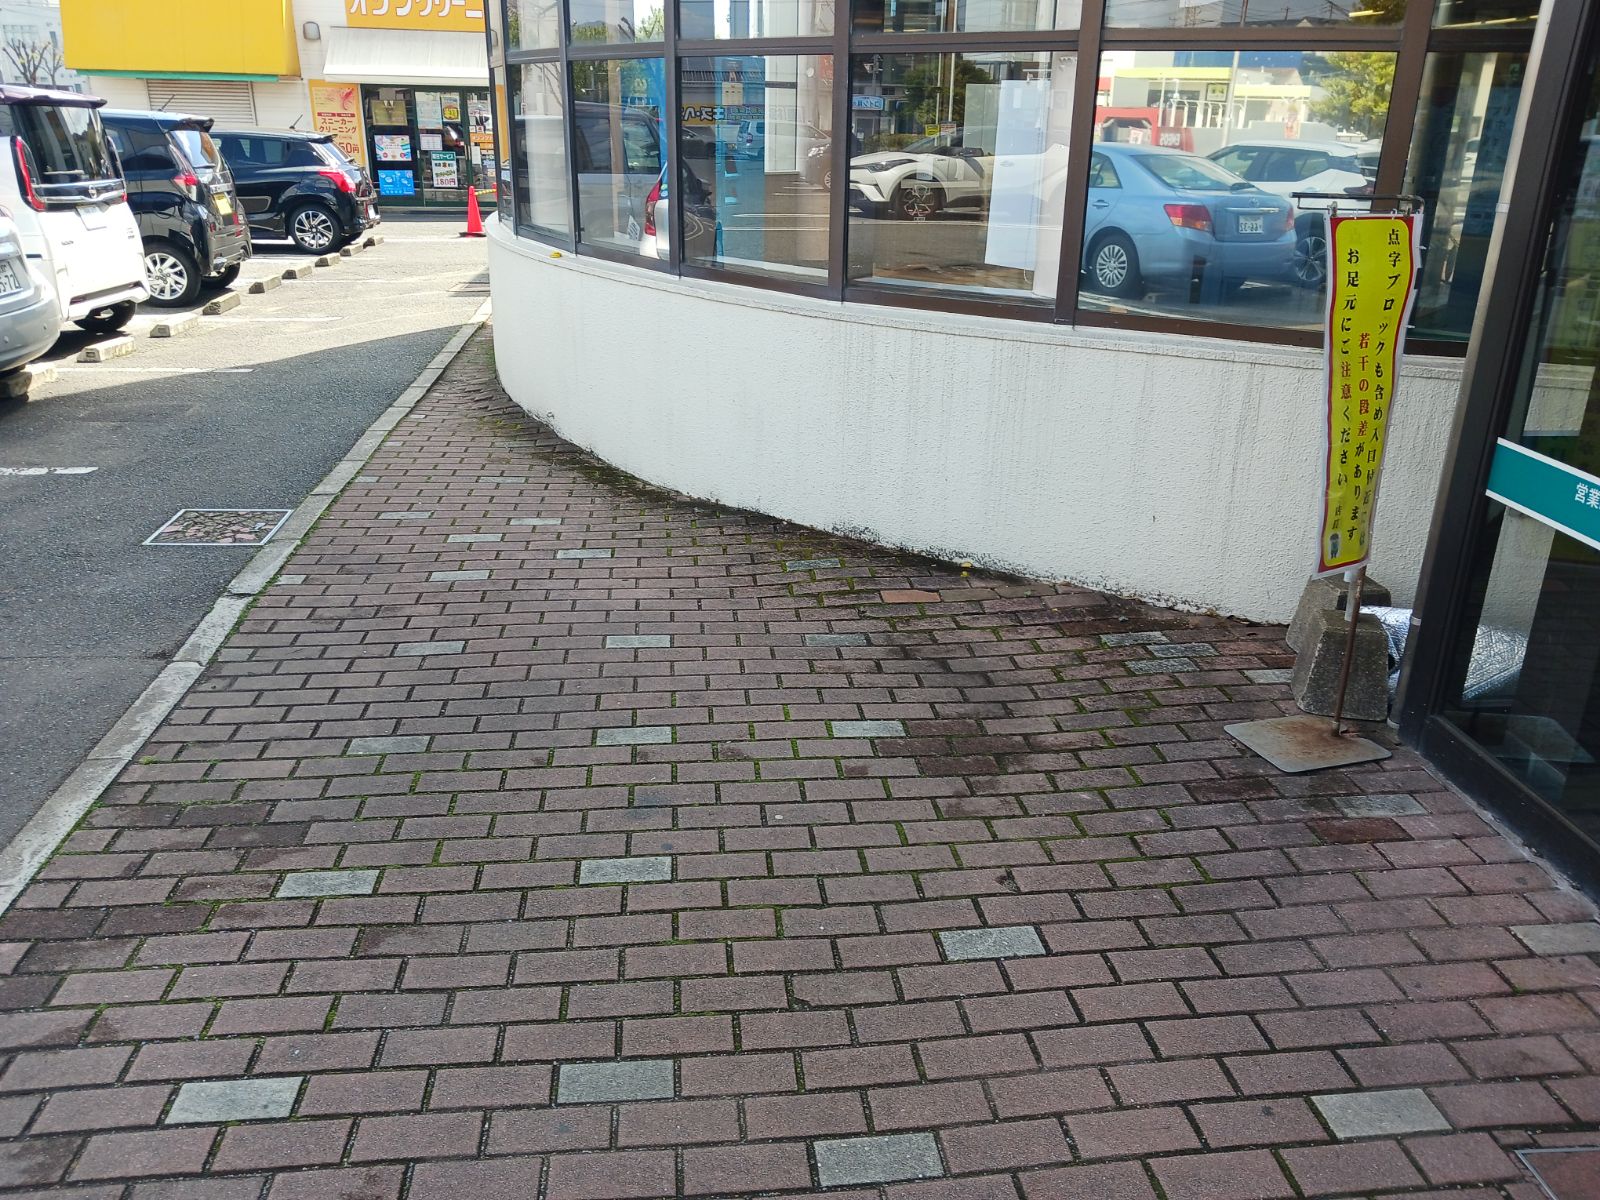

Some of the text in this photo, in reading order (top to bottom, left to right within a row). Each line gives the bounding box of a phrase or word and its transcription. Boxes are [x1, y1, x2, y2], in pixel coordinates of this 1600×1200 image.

[1337, 248, 1360, 486] お足元にご注意ください
[1347, 333, 1371, 541] 若干の段差があります
[1574, 482, 1600, 510] 営業
